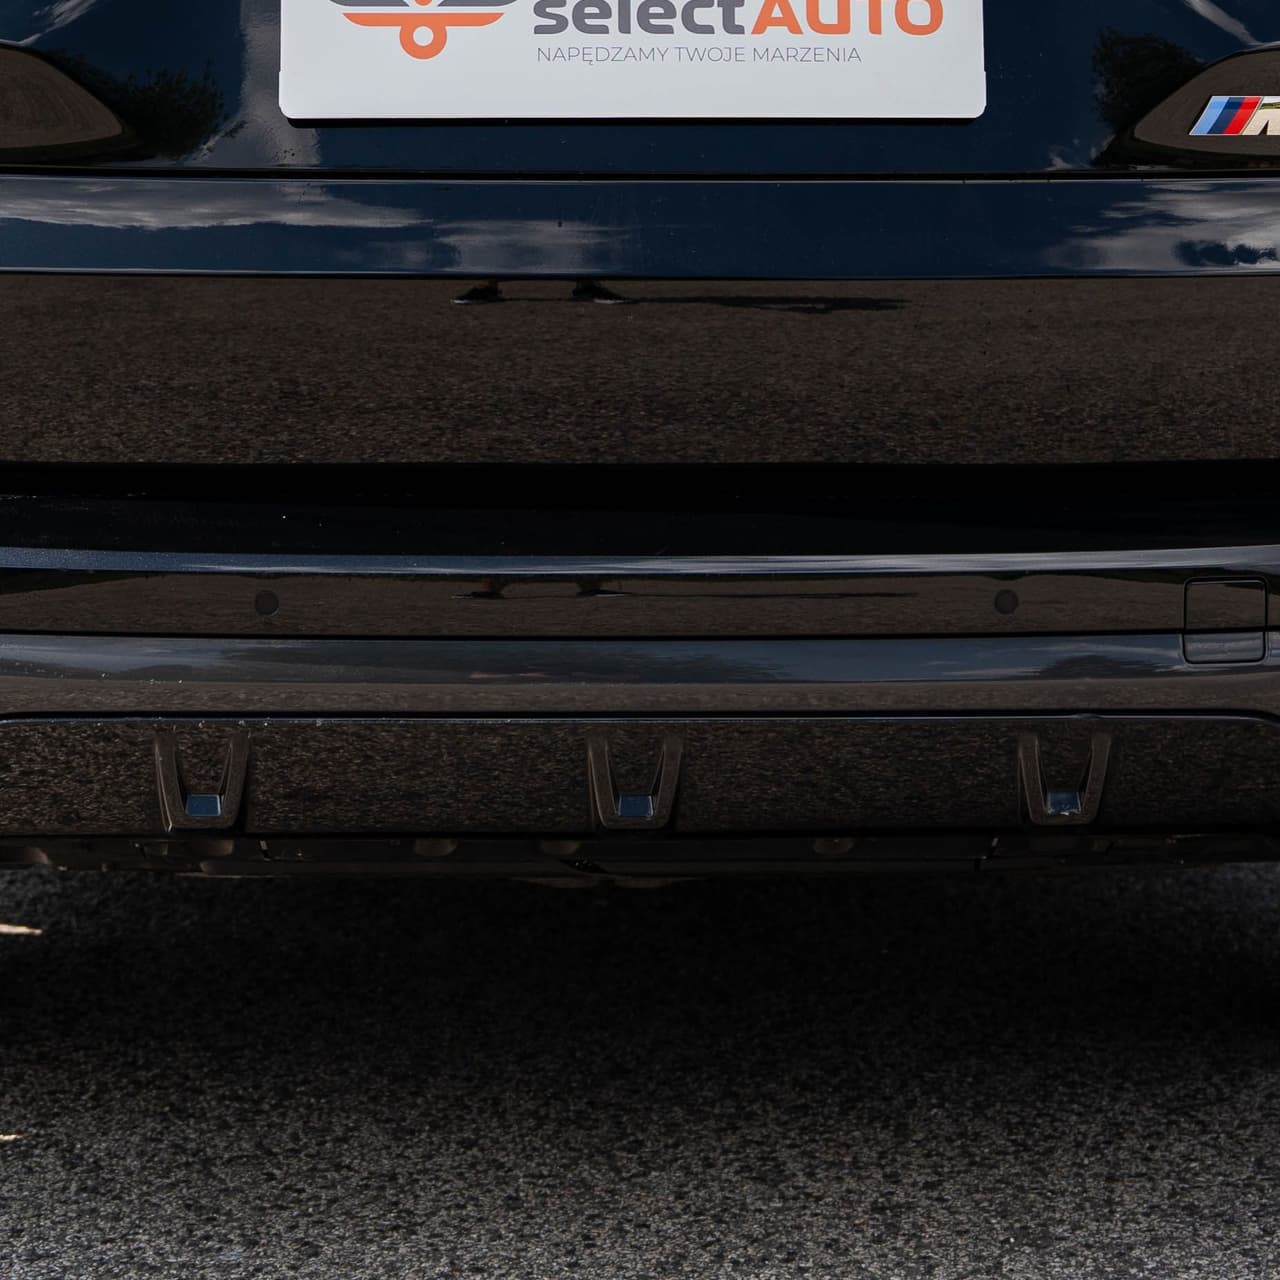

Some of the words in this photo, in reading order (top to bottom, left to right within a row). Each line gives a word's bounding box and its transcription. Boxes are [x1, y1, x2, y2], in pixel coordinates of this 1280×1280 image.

[536, 46, 669, 66] NAPĘDZAMY
[674, 46, 746, 62] TWOJE
[752, 46, 862, 62] MARZENIA
